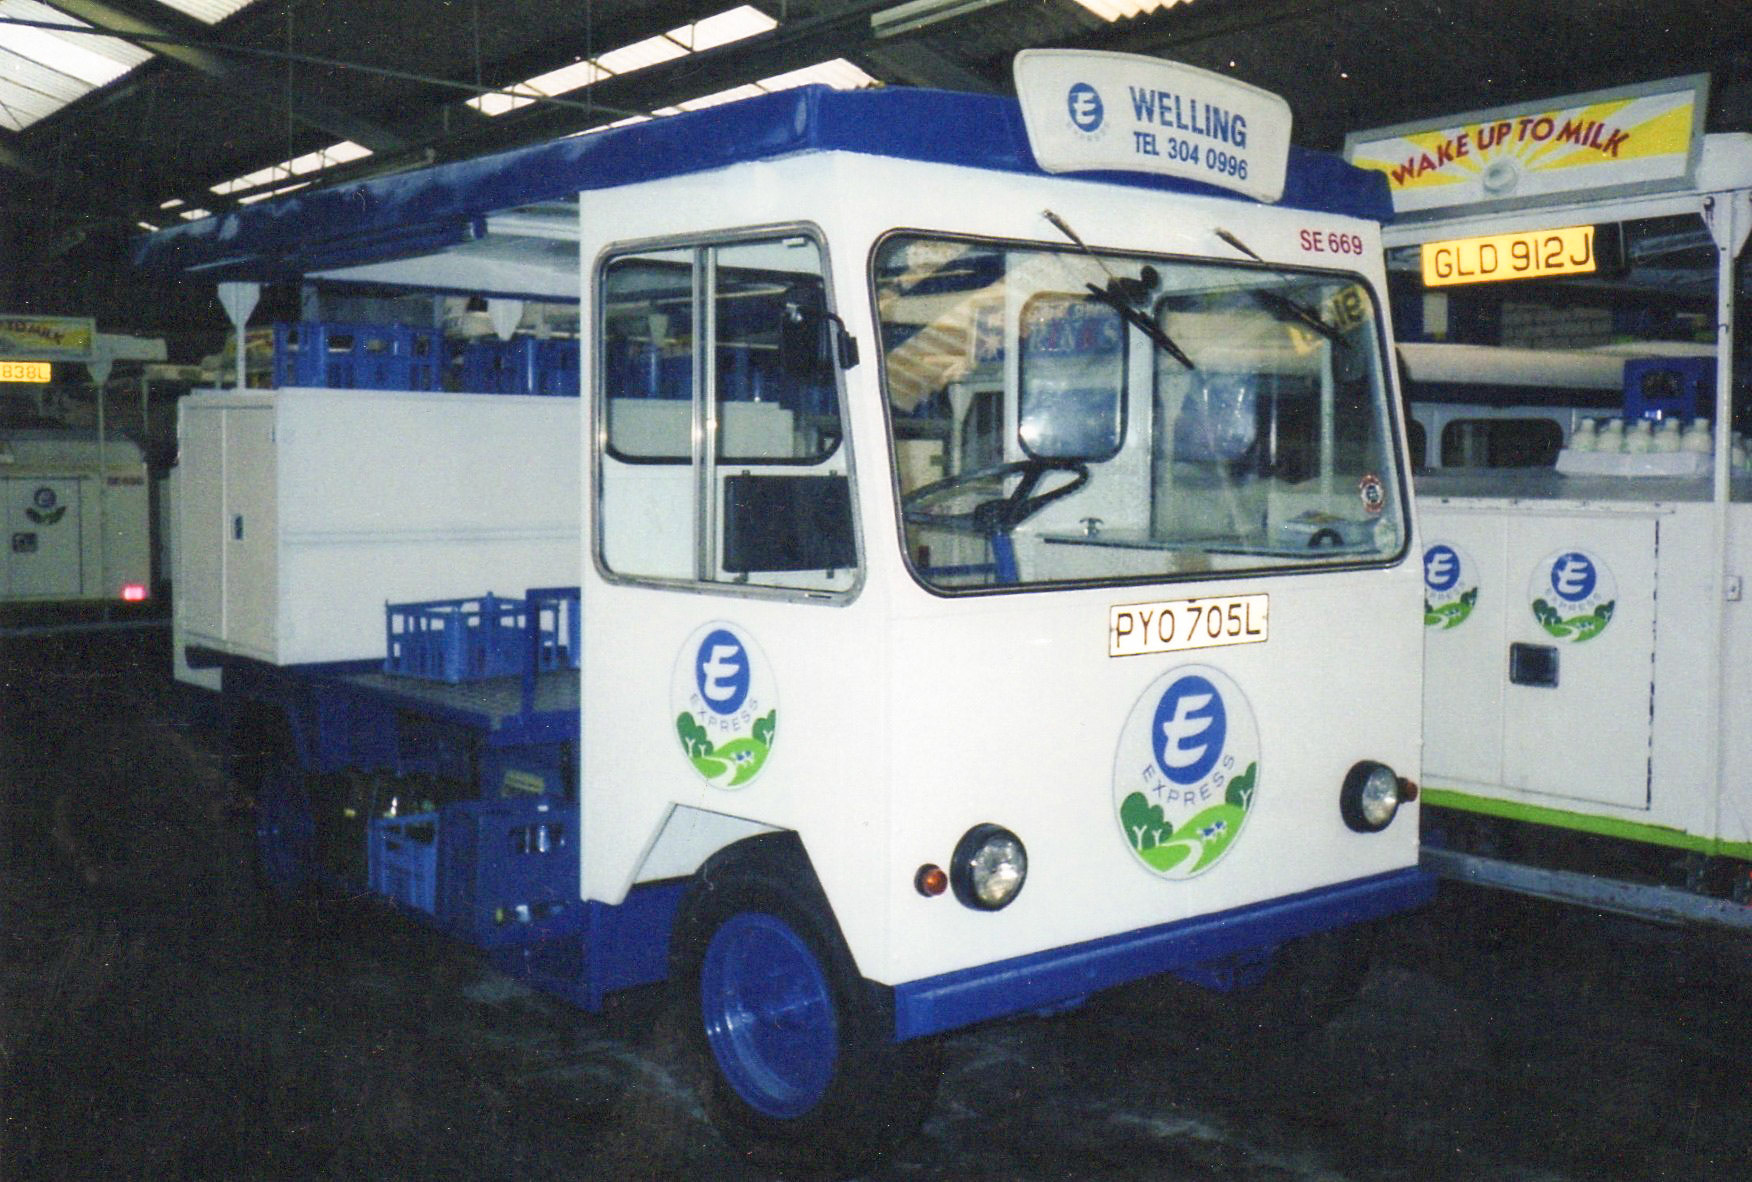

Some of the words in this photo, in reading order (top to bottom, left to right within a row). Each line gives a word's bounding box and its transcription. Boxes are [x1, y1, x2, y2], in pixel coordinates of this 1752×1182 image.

[1129, 86, 1247, 149] WELLING
[1133, 131, 1160, 156] TEL
[1168, 138, 1200, 165] 304
[1206, 149, 1248, 180] 0996
[1391, 134, 1469, 186] WAKE
[1476, 123, 1512, 151] UP
[1517, 117, 1555, 142] TO
[1556, 120, 1630, 158] MILK
[1300, 229, 1324, 252] SE
[1328, 233, 1363, 255] 669
[1435, 243, 1498, 278] GLD
[1512, 236, 1591, 272] 912J
[1116, 609, 1176, 648] PYO
[1186, 603, 1261, 641] 705L
[690, 693, 759, 732] EXPRESS
[1142, 754, 1235, 806] EXPRESS
